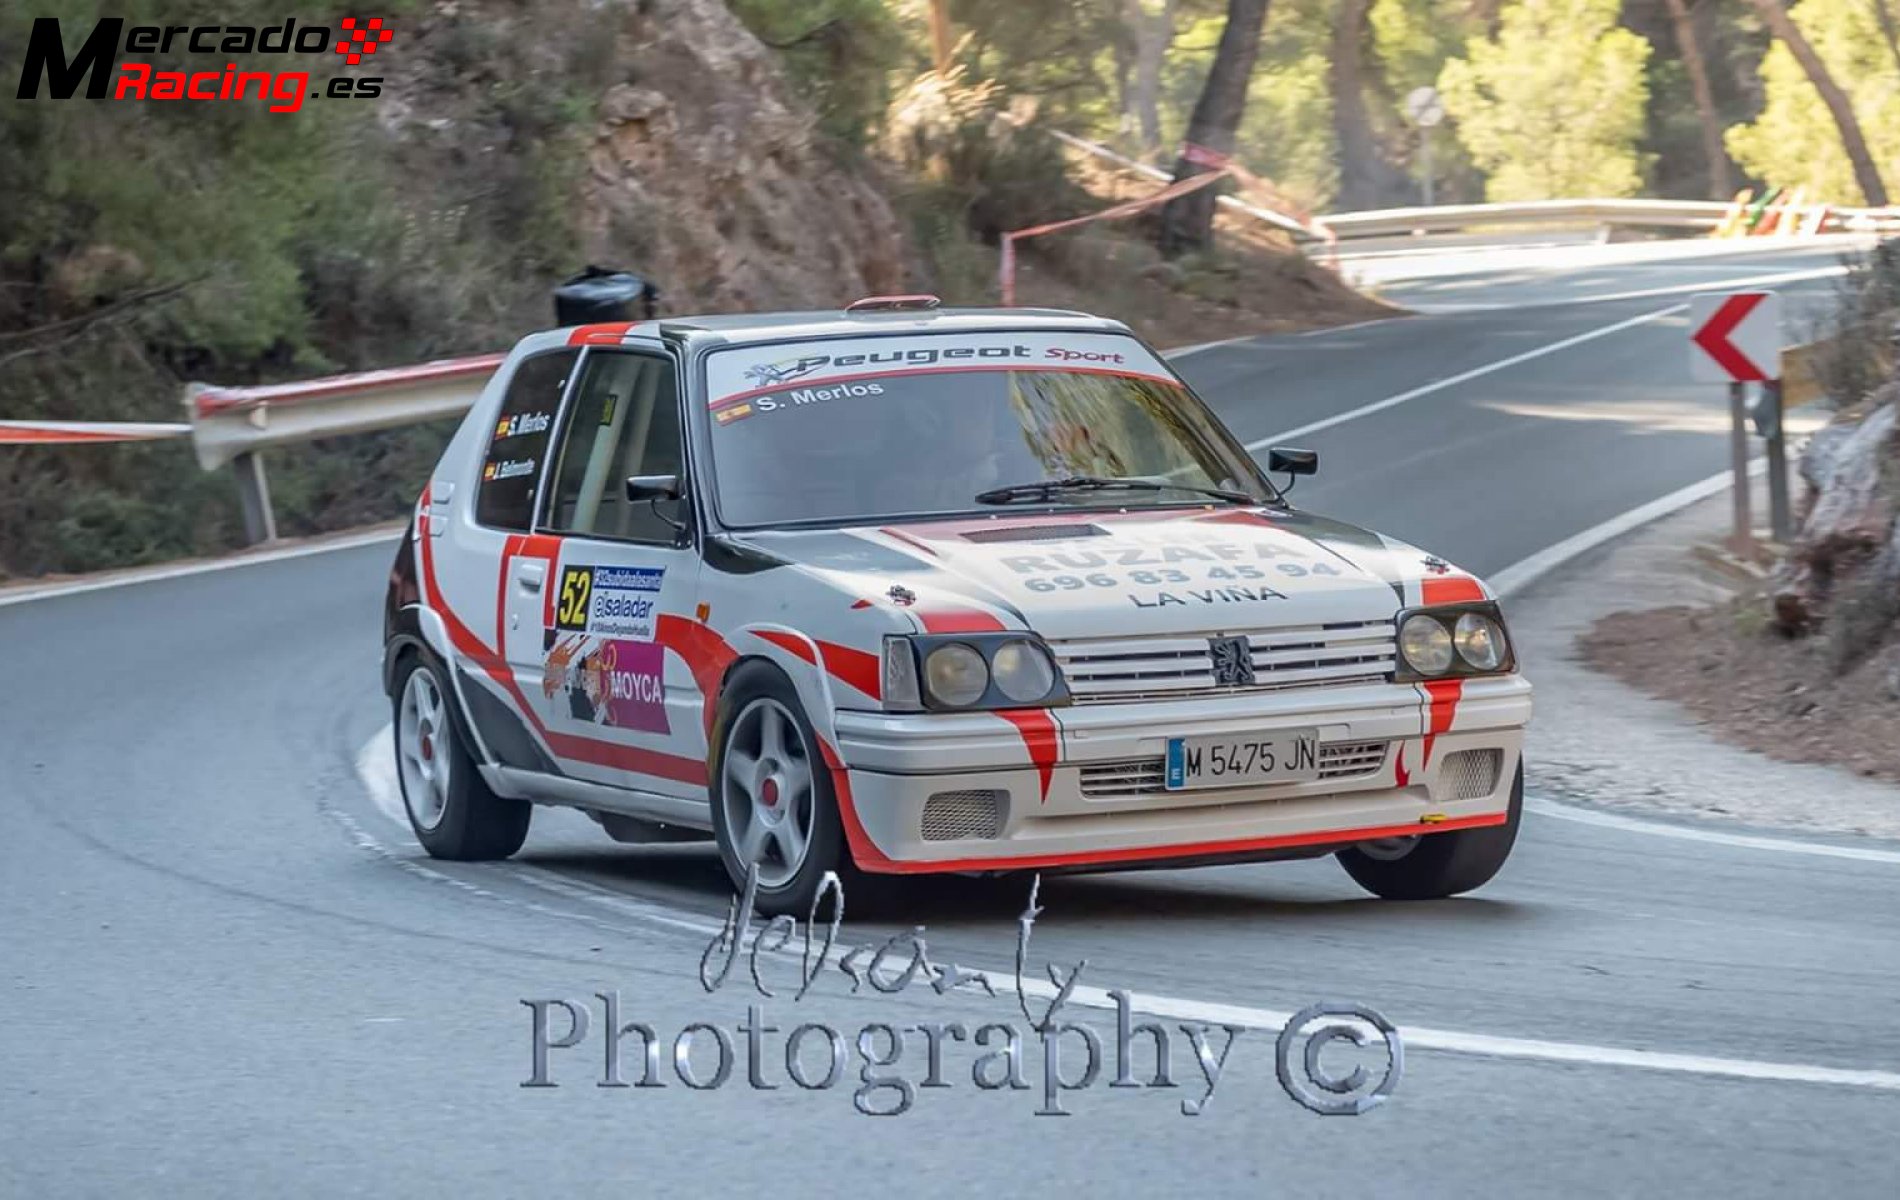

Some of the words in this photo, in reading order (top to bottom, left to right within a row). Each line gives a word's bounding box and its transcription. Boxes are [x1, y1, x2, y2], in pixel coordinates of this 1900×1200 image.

[1045, 347, 1125, 365] Sport
[756, 396, 786, 412] S.
[790, 383, 884, 405] Merlos
[518, 411, 550, 434] Merlos
[999, 541, 1301, 574] RUZAFA
[1024, 573, 1118, 594] 696
[1127, 568, 1191, 586] 83
[1207, 563, 1266, 582] 45
[1275, 560, 1342, 578] 94
[560, 570, 591, 625] 52
[1128, 592, 1187, 608] LA
[1188, 584, 1289, 604] VIÑA
[609, 670, 662, 704] MOYCA
[1186, 746, 1202, 777] M
[1211, 742, 1275, 776] 5475
[1285, 735, 1316, 771] JN
